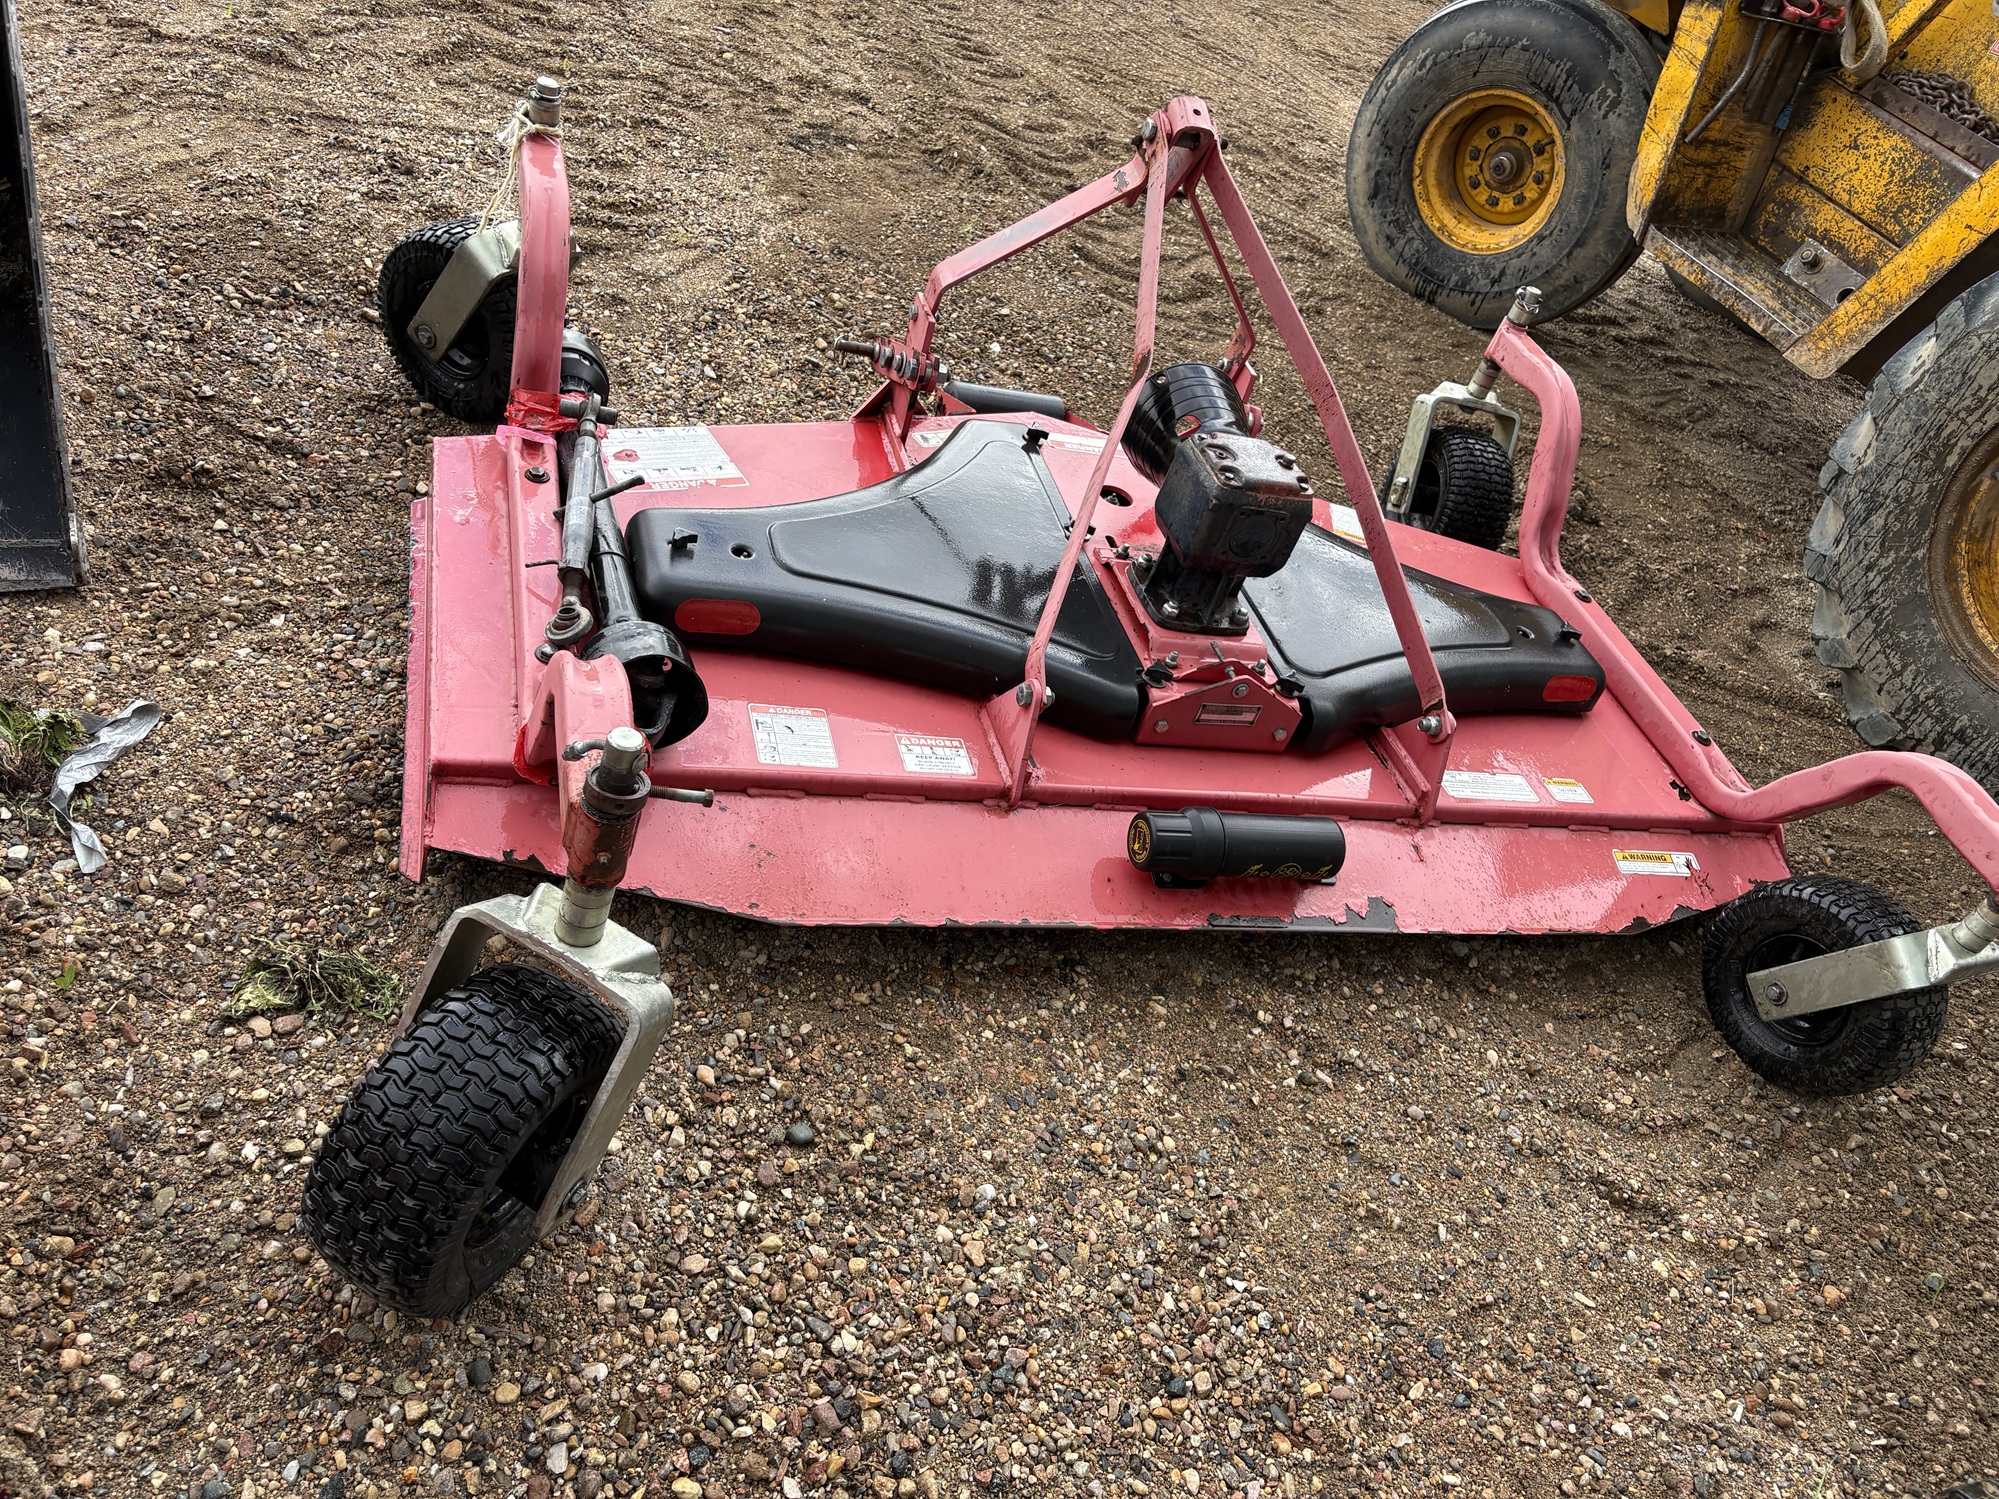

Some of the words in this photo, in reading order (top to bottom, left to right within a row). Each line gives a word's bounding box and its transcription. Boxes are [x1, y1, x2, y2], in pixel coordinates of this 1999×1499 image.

[776, 707, 812, 716] DANGER
[910, 737, 961, 747] DANGER
[1628, 853, 1667, 861] WARNING
